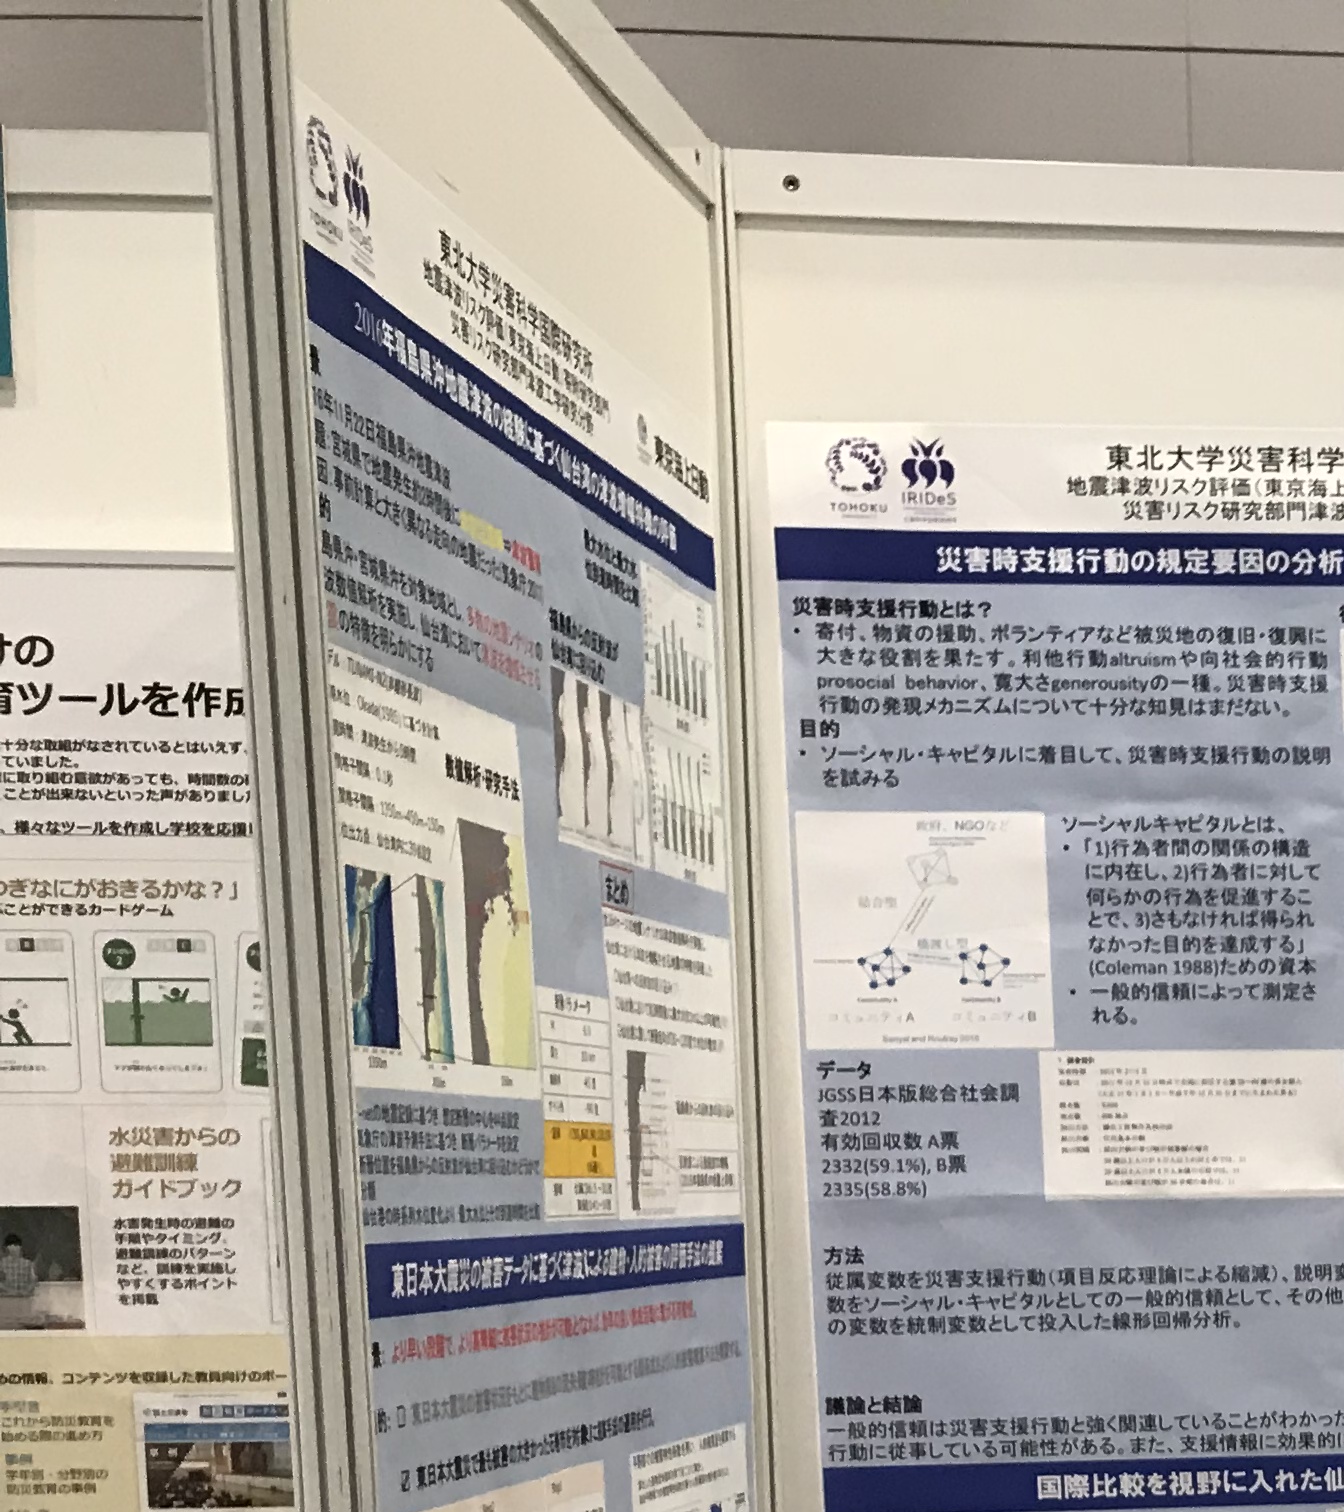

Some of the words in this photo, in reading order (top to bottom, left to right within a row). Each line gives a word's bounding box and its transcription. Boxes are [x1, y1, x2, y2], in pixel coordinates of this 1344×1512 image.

[829, 502, 888, 513] TOHOKU
[901, 492, 957, 506] IRIDeS
[792, 597, 993, 620] 災害時支援行動とは？
[816, 673, 896, 694] prosocial
[800, 719, 840, 740] 目的
[2, 756, 80, 770] ていました。
[822, 767, 900, 788] を試みる
[1061, 814, 1285, 834] ソーシャルキャピタルとは、
[1086, 887, 1311, 907] 何らかの行為を促進するこ
[1090, 980, 1318, 1001] 一般的信頼によって測定さ
[1091, 1005, 1139, 1026] れる。
[817, 1060, 872, 1080] データ
[820, 1109, 881, 1128] 査2012
[821, 1132, 922, 1152] 有効回収数
[112, 1178, 242, 1199] ガイドブック
[823, 1245, 865, 1265] 方法
[827, 1309, 1243, 1337] の変数を統制変数として投入した線形回帰分析。
[825, 1395, 923, 1416] 議論と結論
